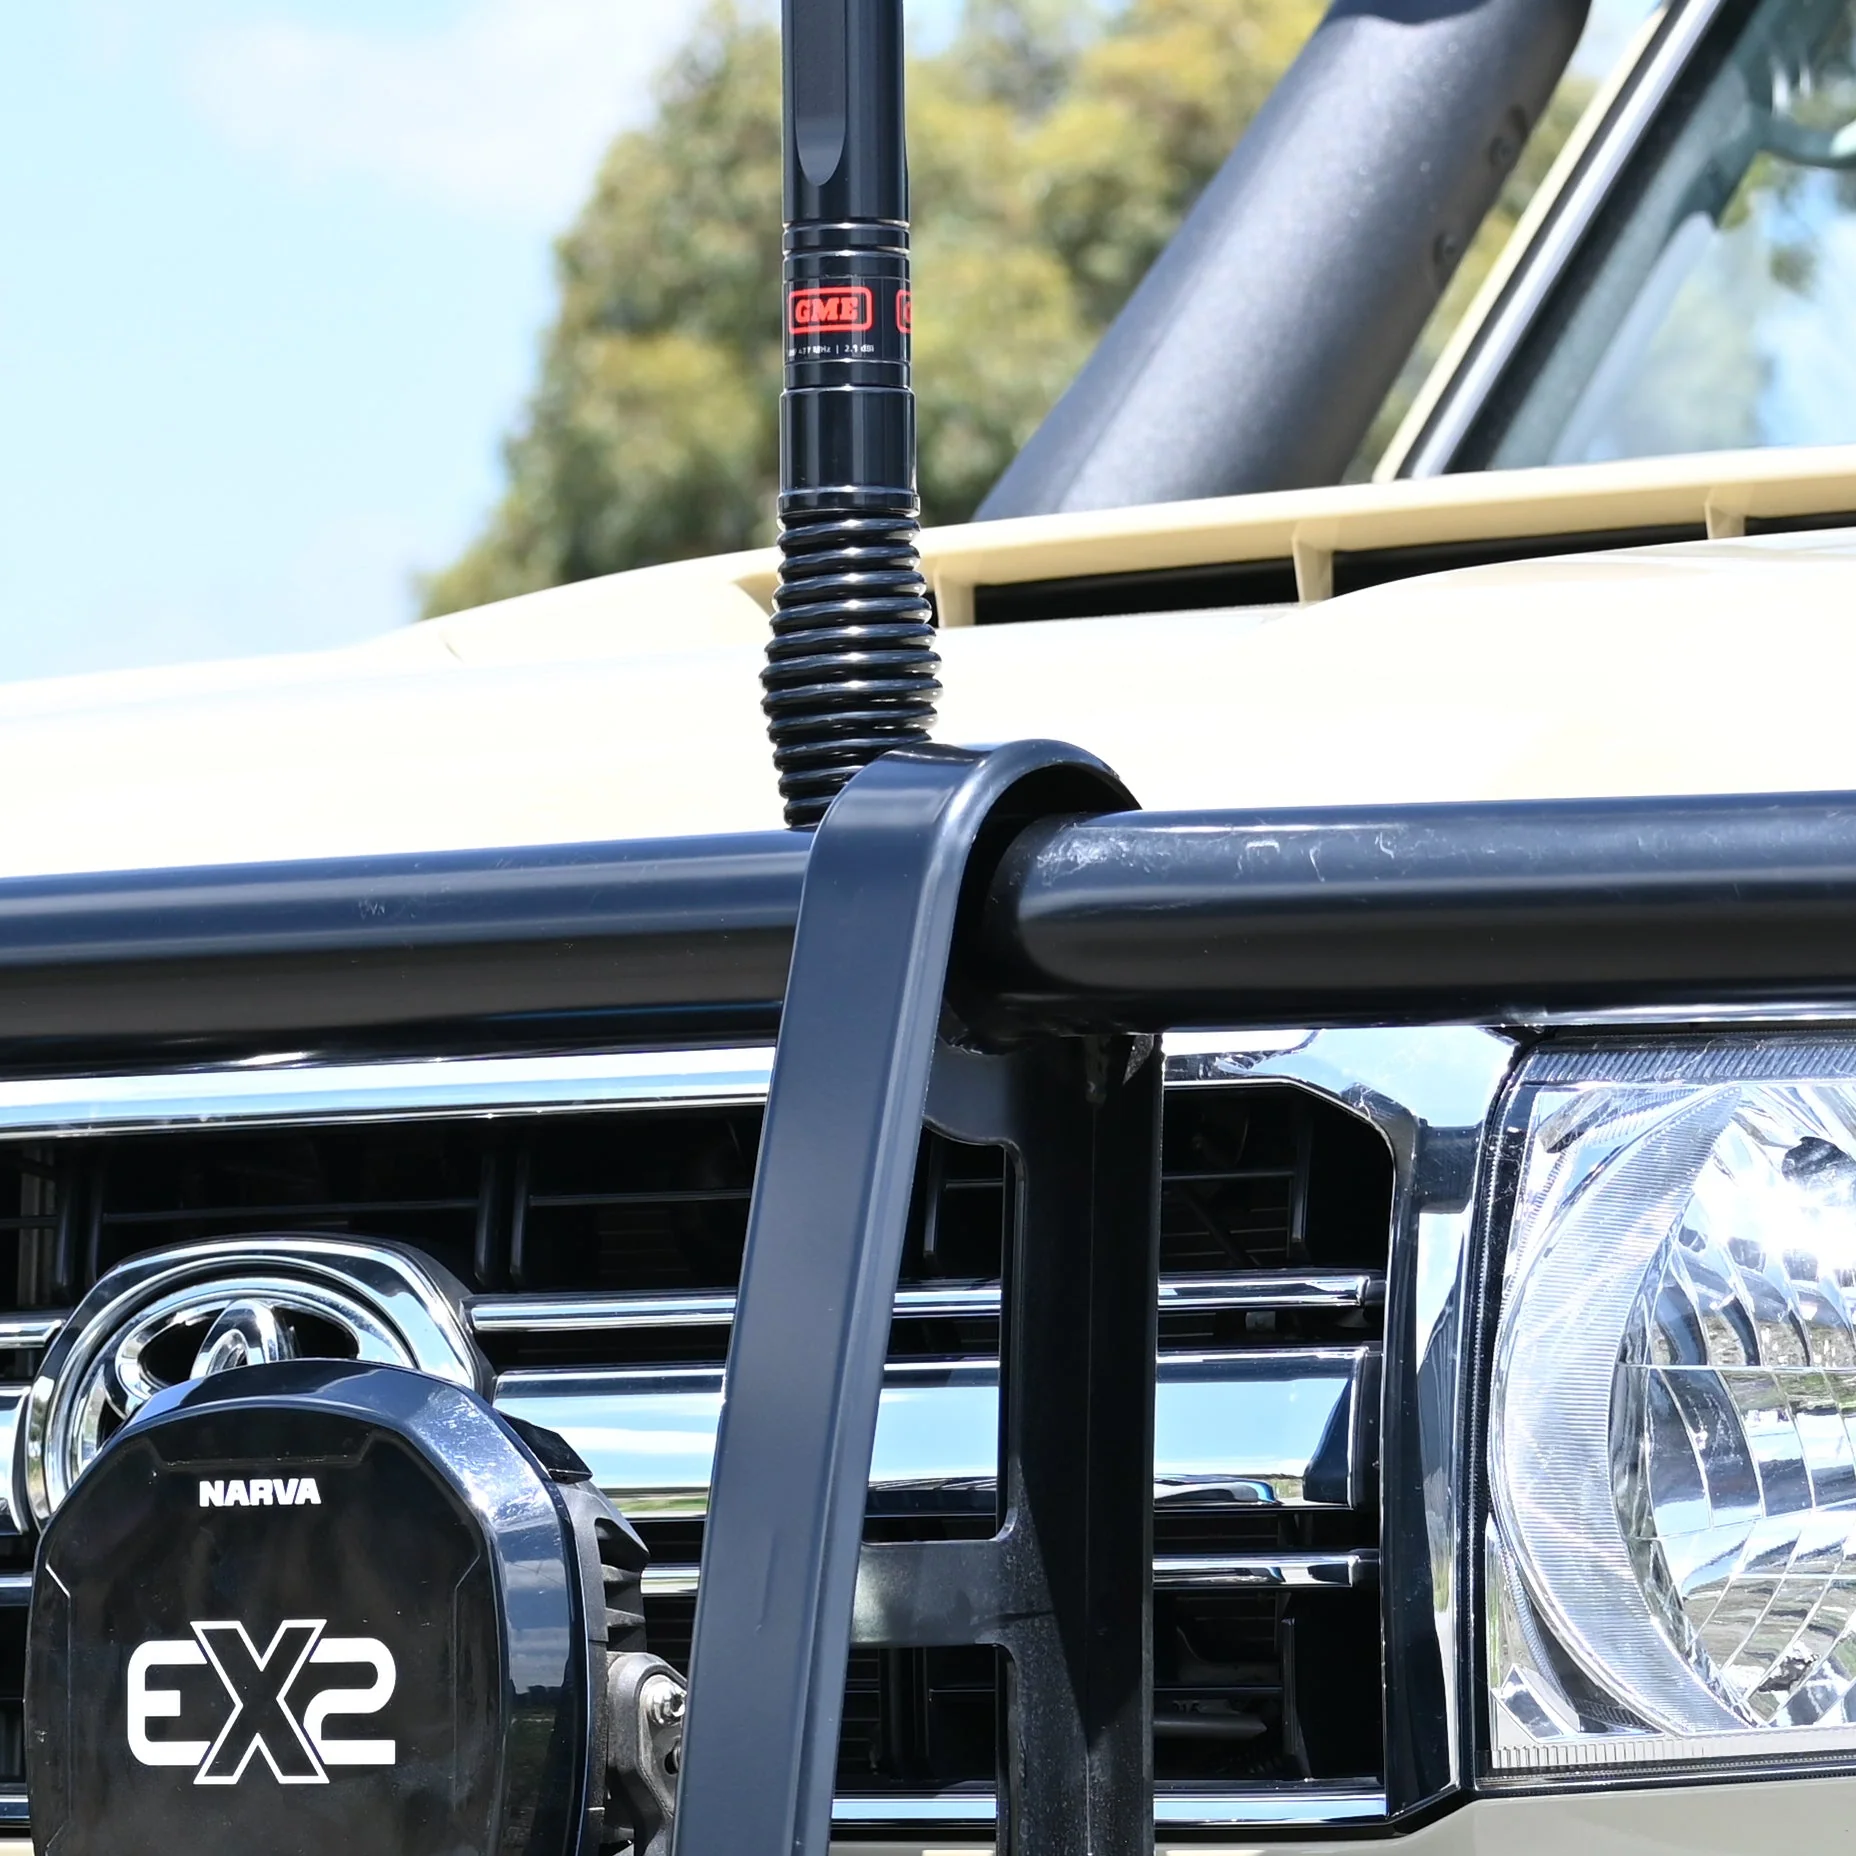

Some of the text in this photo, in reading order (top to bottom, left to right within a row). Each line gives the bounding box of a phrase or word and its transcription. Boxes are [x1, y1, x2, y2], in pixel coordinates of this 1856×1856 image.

[795, 297, 858, 323] GME
[199, 1478, 322, 1507] NARVA
[127, 1618, 397, 1785] EX2
